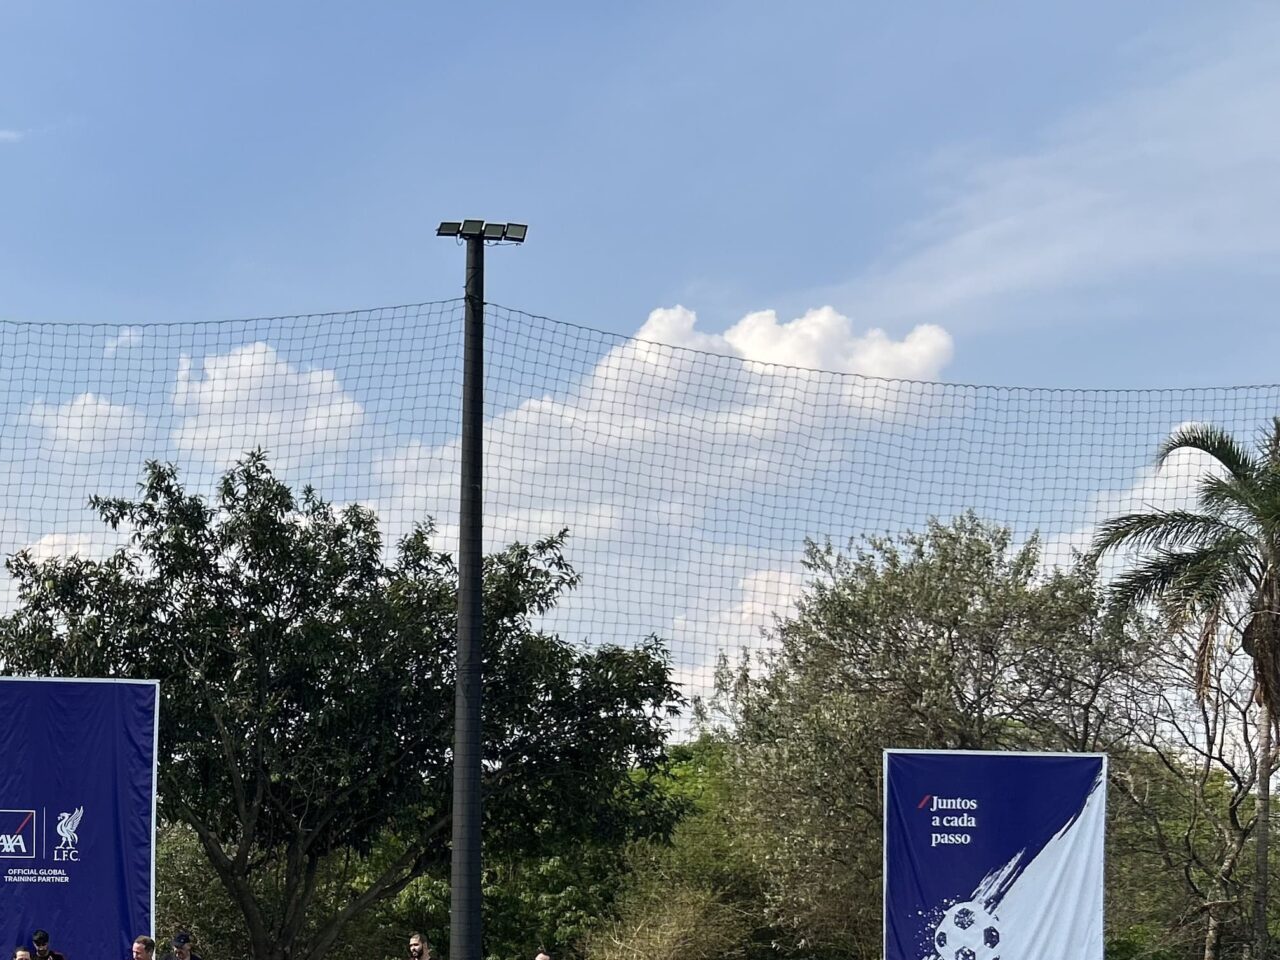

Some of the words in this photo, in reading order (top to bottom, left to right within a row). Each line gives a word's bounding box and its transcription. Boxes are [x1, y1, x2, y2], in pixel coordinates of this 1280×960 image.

[930, 796, 978, 811] Juntos
[931, 815, 940, 826] a
[942, 813, 976, 827] cada
[931, 833, 971, 847] passo
[3, 875, 37, 883] TRAINING
[37, 875, 70, 883] PARTNER
[7, 868, 38, 876] OFFICIAL
[38, 868, 67, 876] GLOBAL
